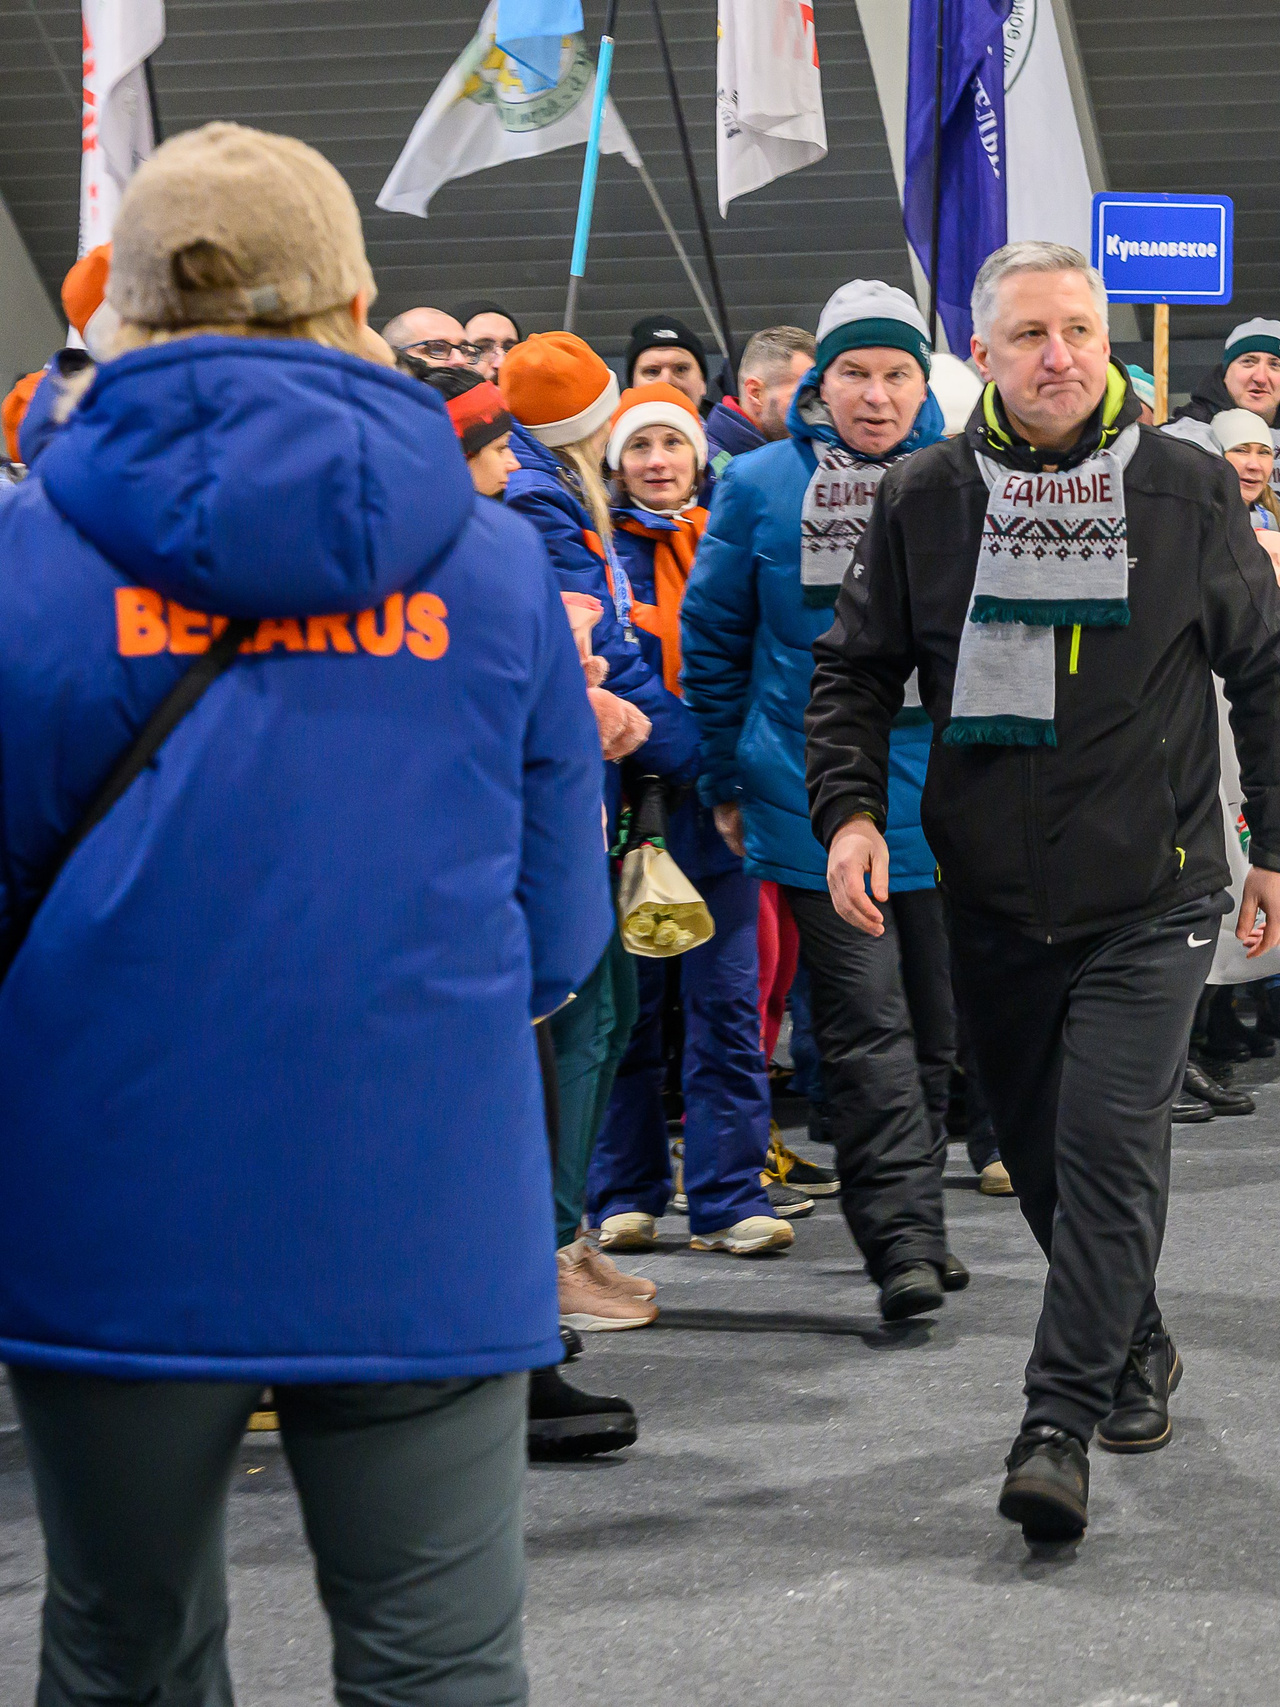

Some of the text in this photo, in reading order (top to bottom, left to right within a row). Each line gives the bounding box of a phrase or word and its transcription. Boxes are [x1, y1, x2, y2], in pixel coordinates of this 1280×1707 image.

[1106, 234, 1218, 263] Купаловское
[815, 481, 879, 512] ЕДИН
[1002, 473, 1113, 508] ЕДИНЫЕ
[114, 586, 450, 661] BEARUS
